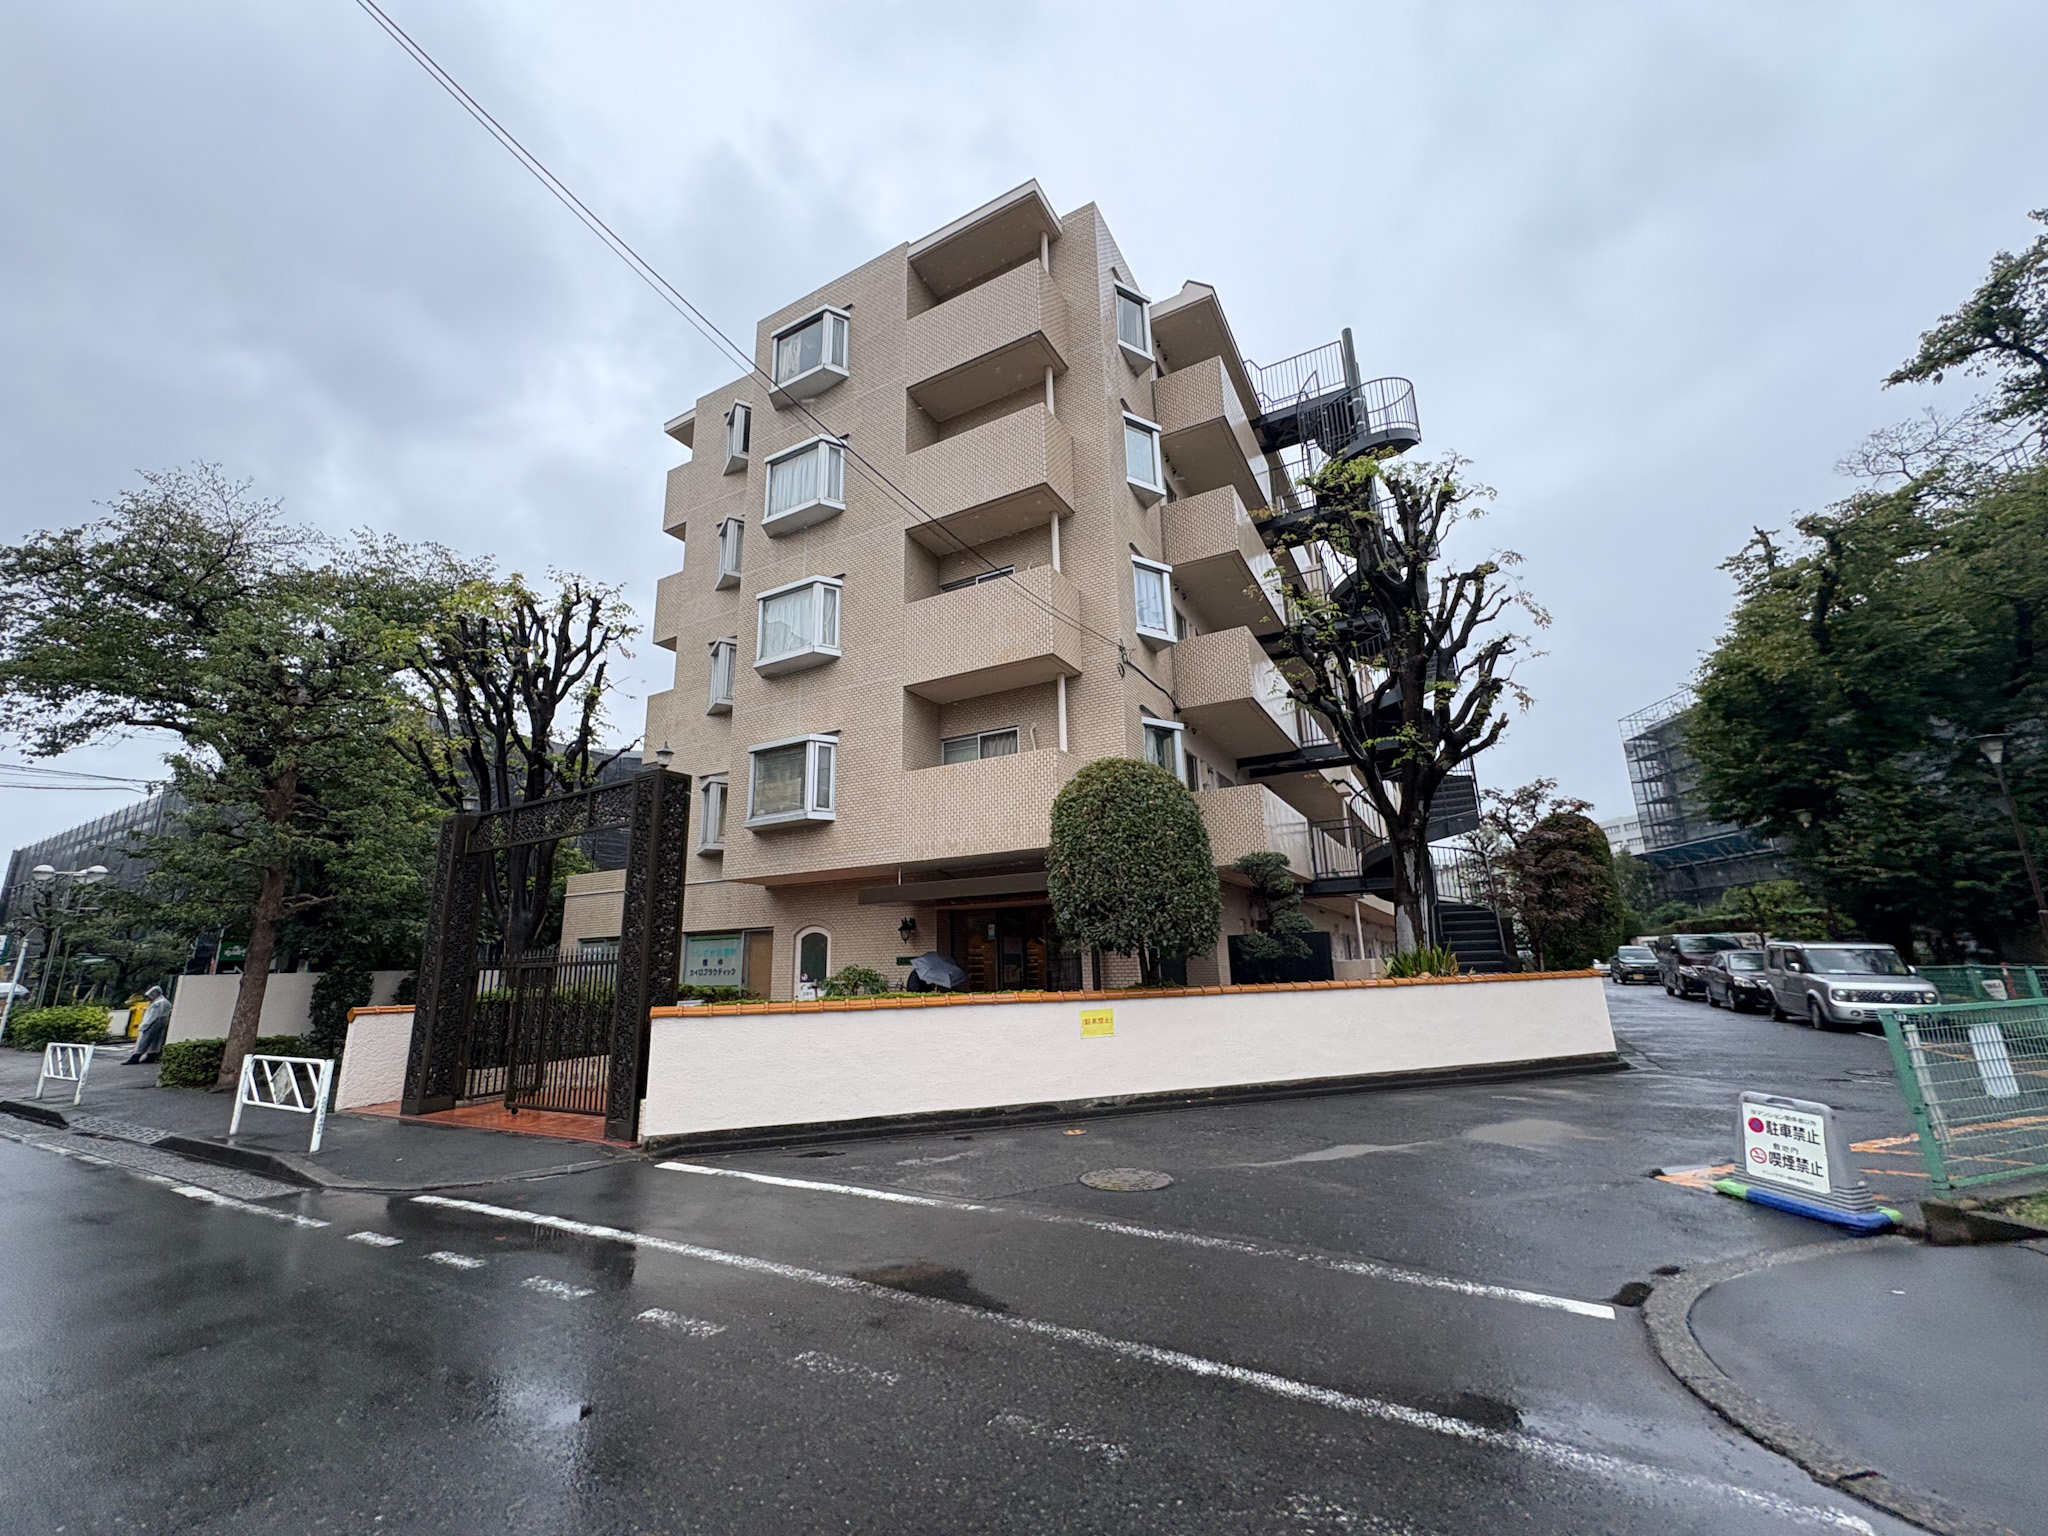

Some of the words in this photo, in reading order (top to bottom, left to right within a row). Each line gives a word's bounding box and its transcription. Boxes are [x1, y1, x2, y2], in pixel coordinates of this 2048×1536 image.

[1766, 1120, 1820, 1145] 駐車禁止
[1768, 1151, 1824, 1177] 喫煙禁止
